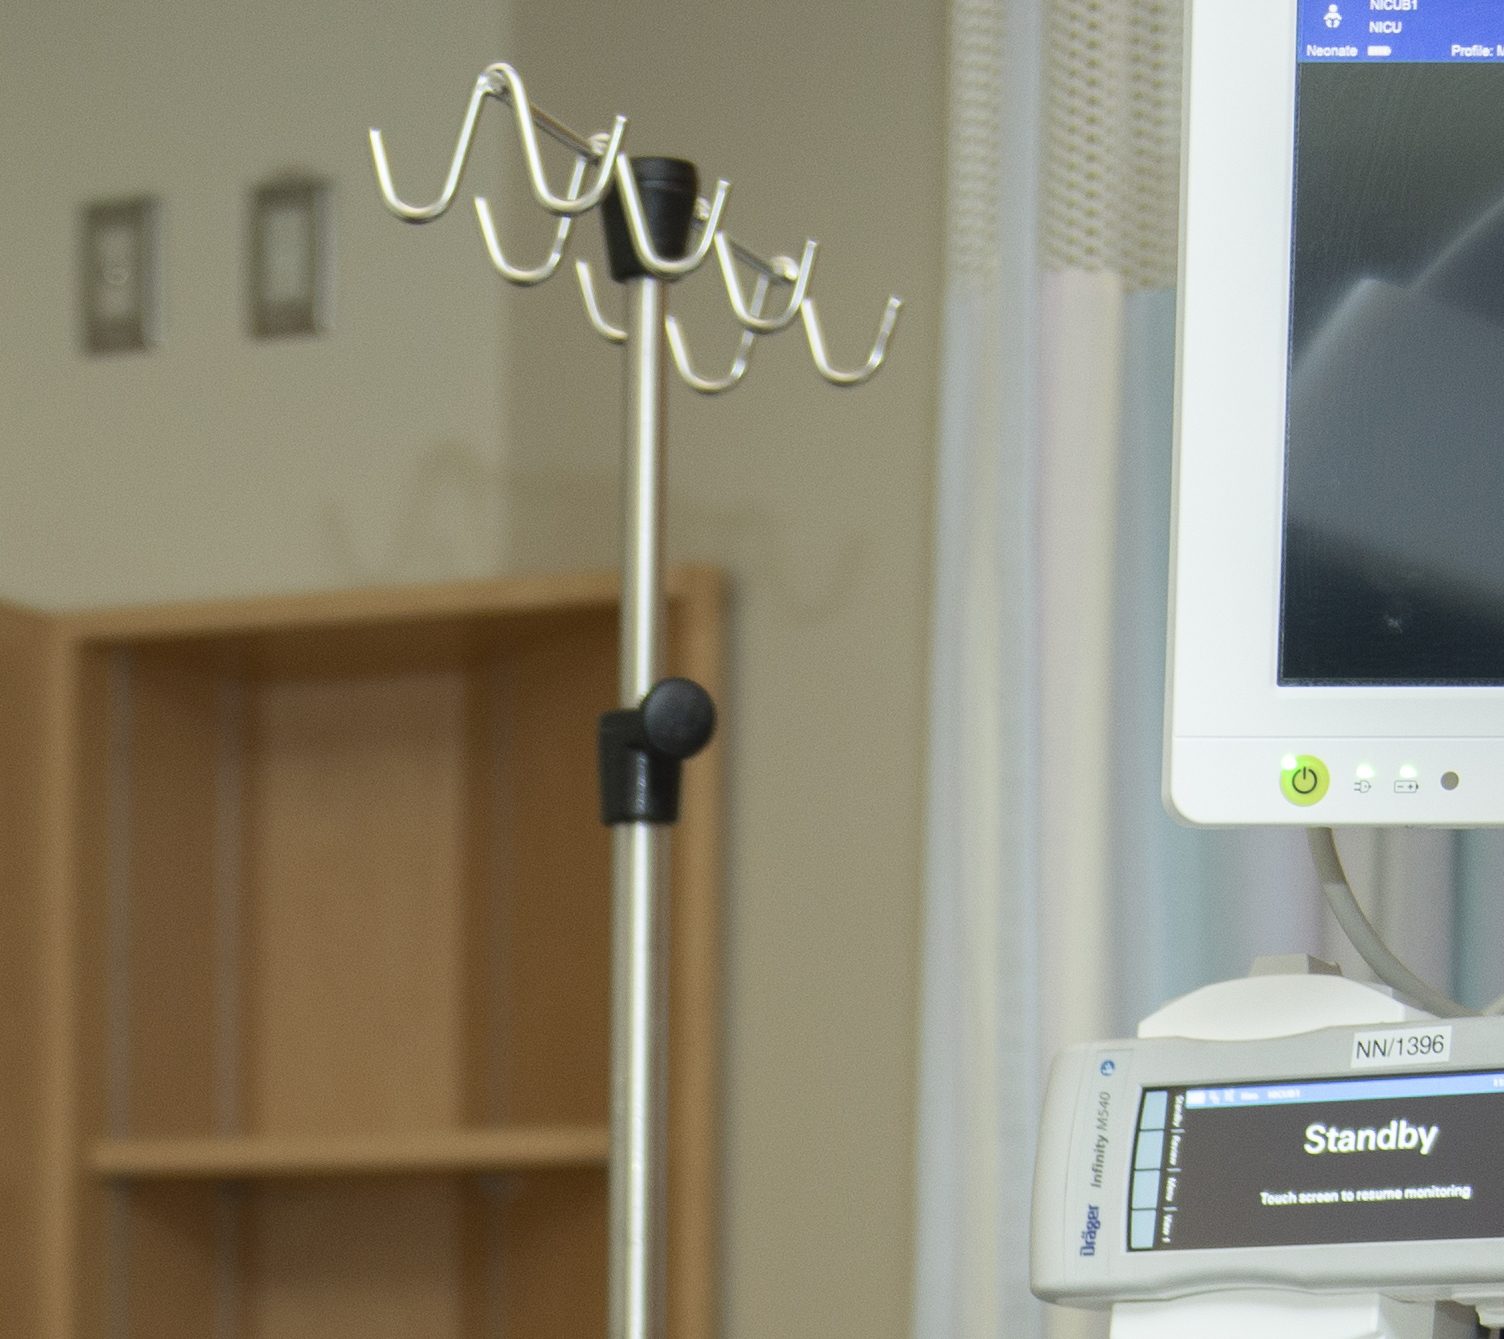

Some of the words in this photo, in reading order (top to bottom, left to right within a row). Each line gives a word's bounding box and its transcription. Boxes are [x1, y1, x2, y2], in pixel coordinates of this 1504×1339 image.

[1368, 21, 1403, 34] NICU
[1305, 44, 1359, 57] Neonate
[1451, 44, 1494, 57] Profile:
[1356, 1034, 1445, 1059] NN/1396
[1095, 1091, 1112, 1133] M540
[1171, 1093, 1185, 1128] Standby
[1168, 1134, 1182, 1167] Review
[1303, 1118, 1440, 1155] Standby
[1090, 1134, 1110, 1188] Infinity
[1165, 1176, 1179, 1202] Menu
[1260, 1191, 1297, 1205] Touch
[1299, 1191, 1339, 1204] screen
[1341, 1190, 1355, 1202] to
[1356, 1189, 1403, 1202] resume
[1404, 1185, 1472, 1201] monitoring
[1080, 1204, 1101, 1258] Dräger
